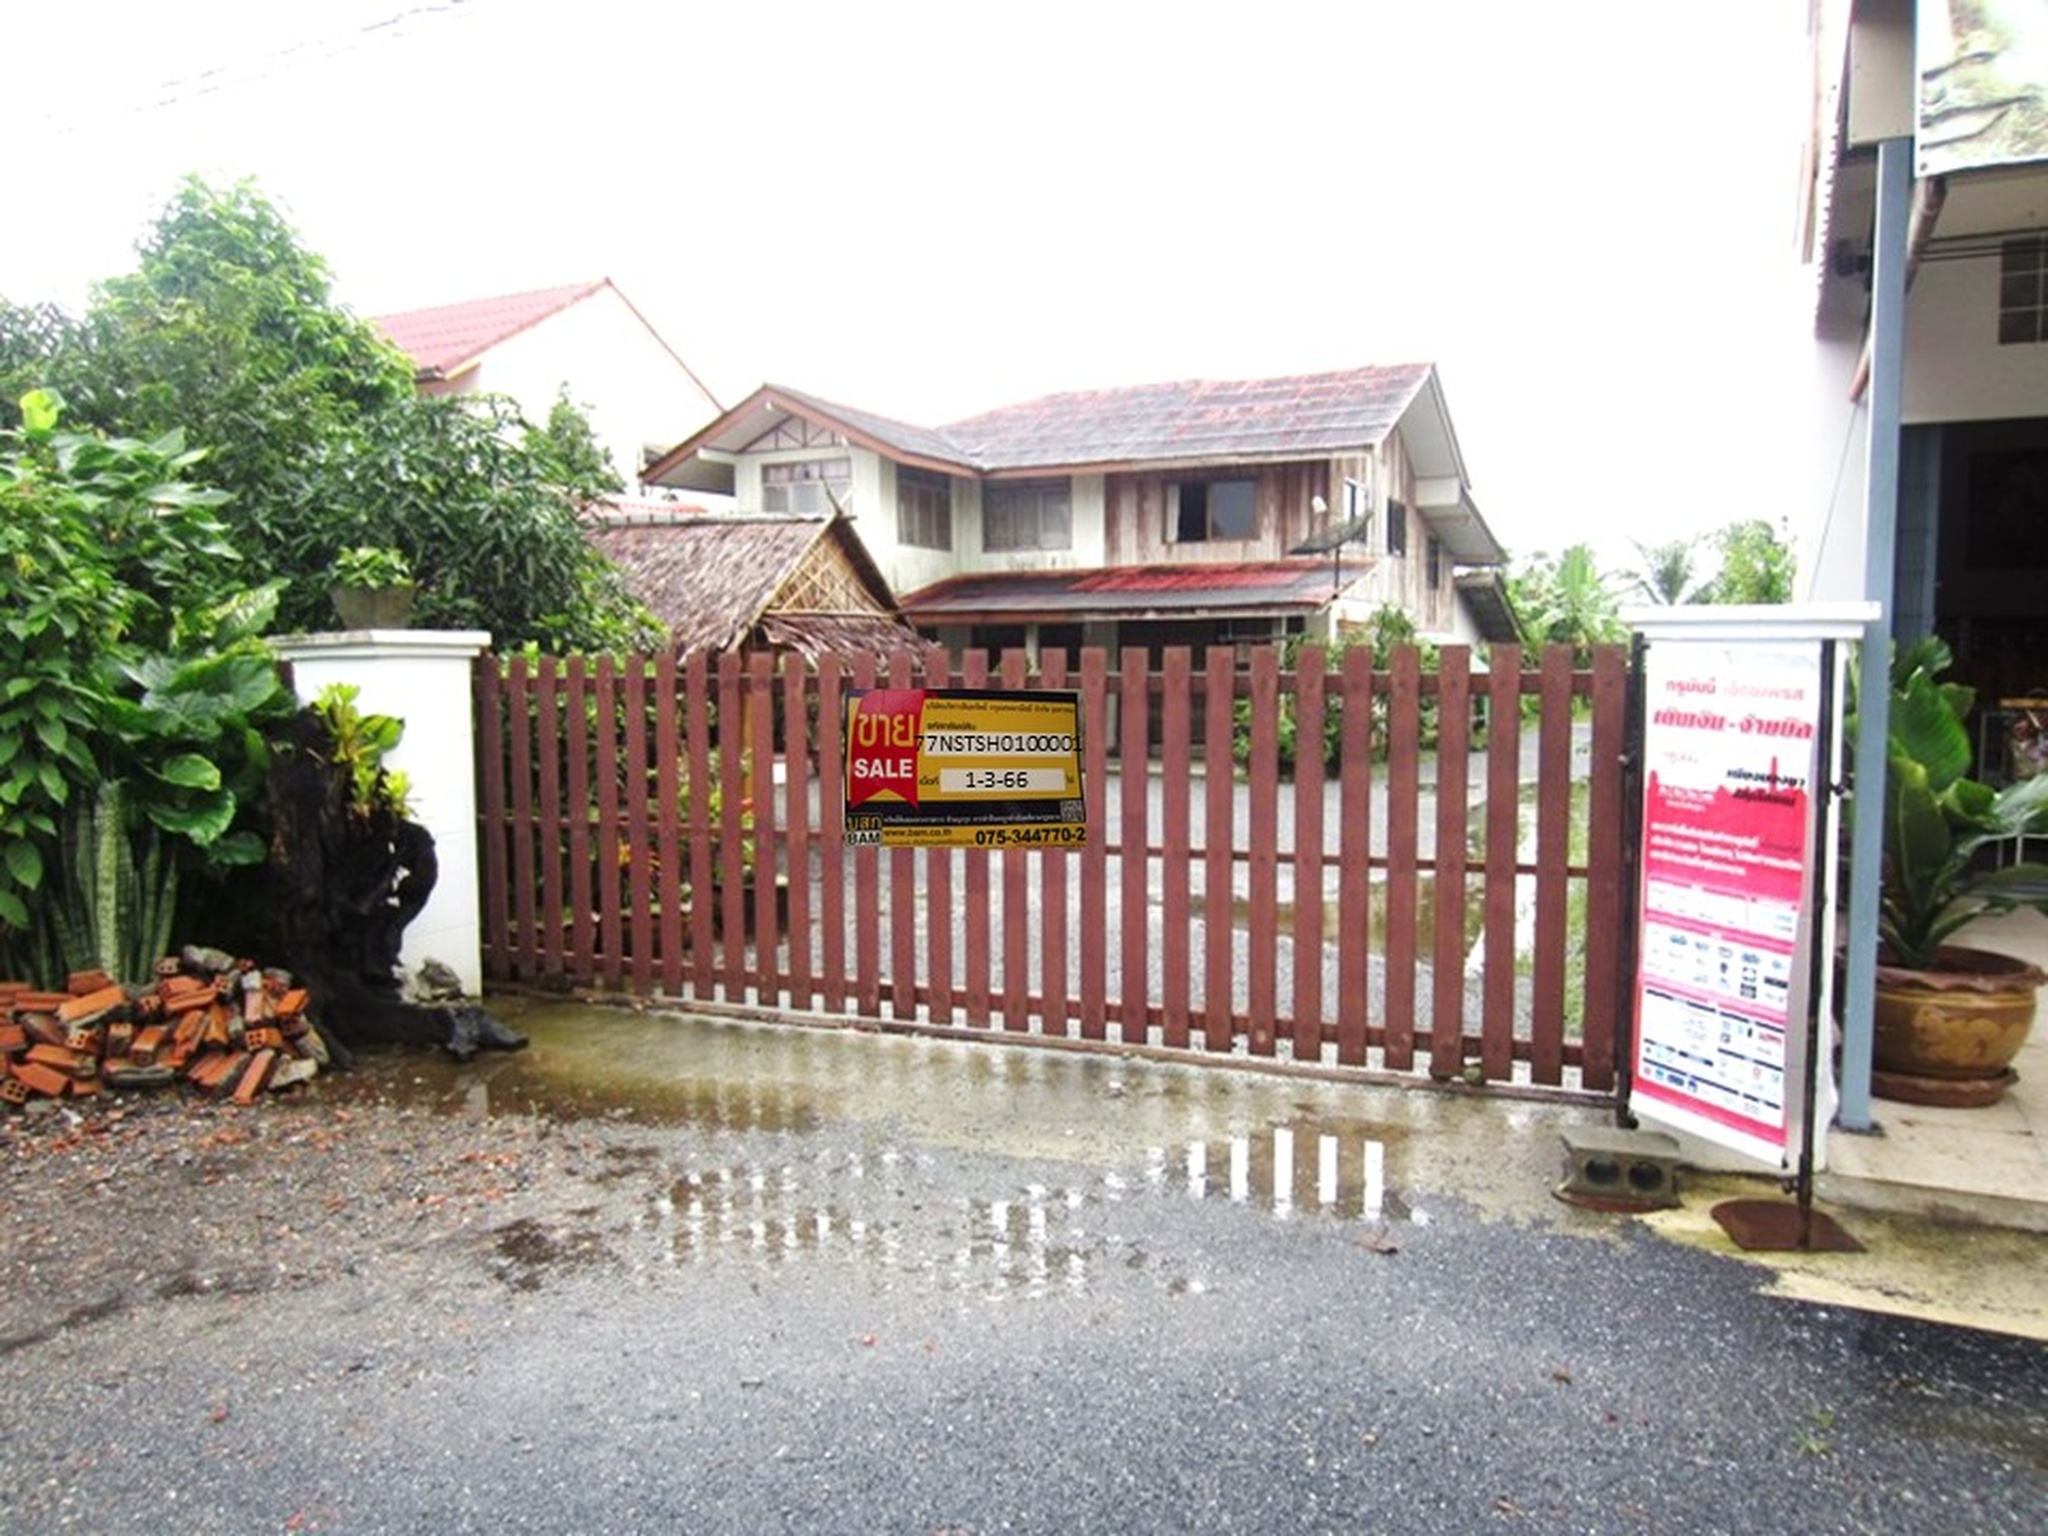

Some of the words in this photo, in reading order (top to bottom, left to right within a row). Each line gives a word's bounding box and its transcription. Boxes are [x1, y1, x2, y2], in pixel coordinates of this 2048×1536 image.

[858, 714, 914, 747] ขาย
[854, 758, 913, 779] SALE
[847, 831, 881, 845] BAM
[976, 827, 1086, 845] 075-344770-2
